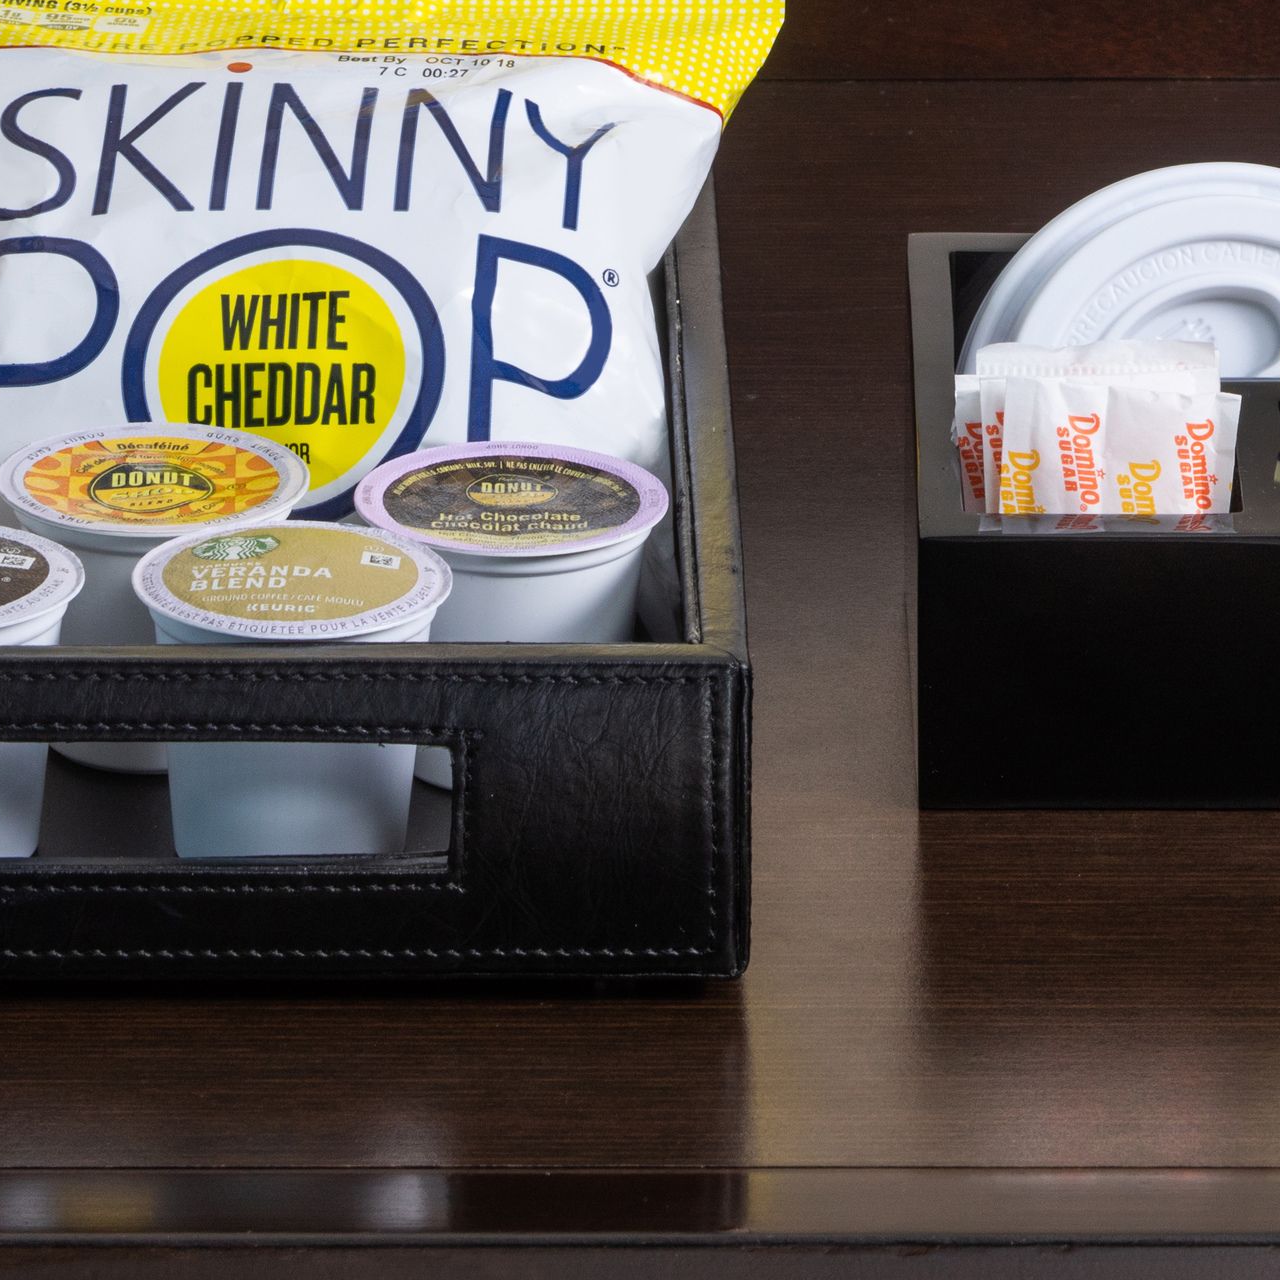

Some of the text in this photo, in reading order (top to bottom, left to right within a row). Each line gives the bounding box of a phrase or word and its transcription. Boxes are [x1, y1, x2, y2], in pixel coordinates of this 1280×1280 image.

[178, 35, 334, 51] POPPED
[356, 37, 606, 54] PERFECTION
[338, 55, 515, 68] Best By OCT 10 18
[379, 66, 470, 78] 7 C 00:27
[220, 290, 350, 351] WHITE
[187, 361, 377, 429] CHEDDAR
[958, 435, 985, 499] SUGAR
[1056, 426, 1078, 492] SUGAR
[1068, 413, 1100, 506] Domino
[1174, 435, 1194, 500] SUGAR
[1186, 418, 1215, 511] Domino
[111, 470, 195, 488] DONUT
[481, 481, 544, 493] DONUT
[1000, 463, 1017, 514] SUGA
[1008, 448, 1041, 514] Domi
[1116, 473, 1135, 513] SUG
[1129, 459, 1162, 515] Dom
[431, 521, 588, 532] Chocolat chaud
[480, 512, 581, 522] Chocolate
[189, 577, 288, 592] BLEND
[191, 565, 333, 581] VERANDA
[202, 593, 248, 603] GROUND
[324, 596, 365, 607] MOULU
[246, 603, 316, 613] KEURIG
[310, 623, 348, 634] POUR
[353, 618, 369, 629] LA
[371, 604, 406, 624] VENTE
